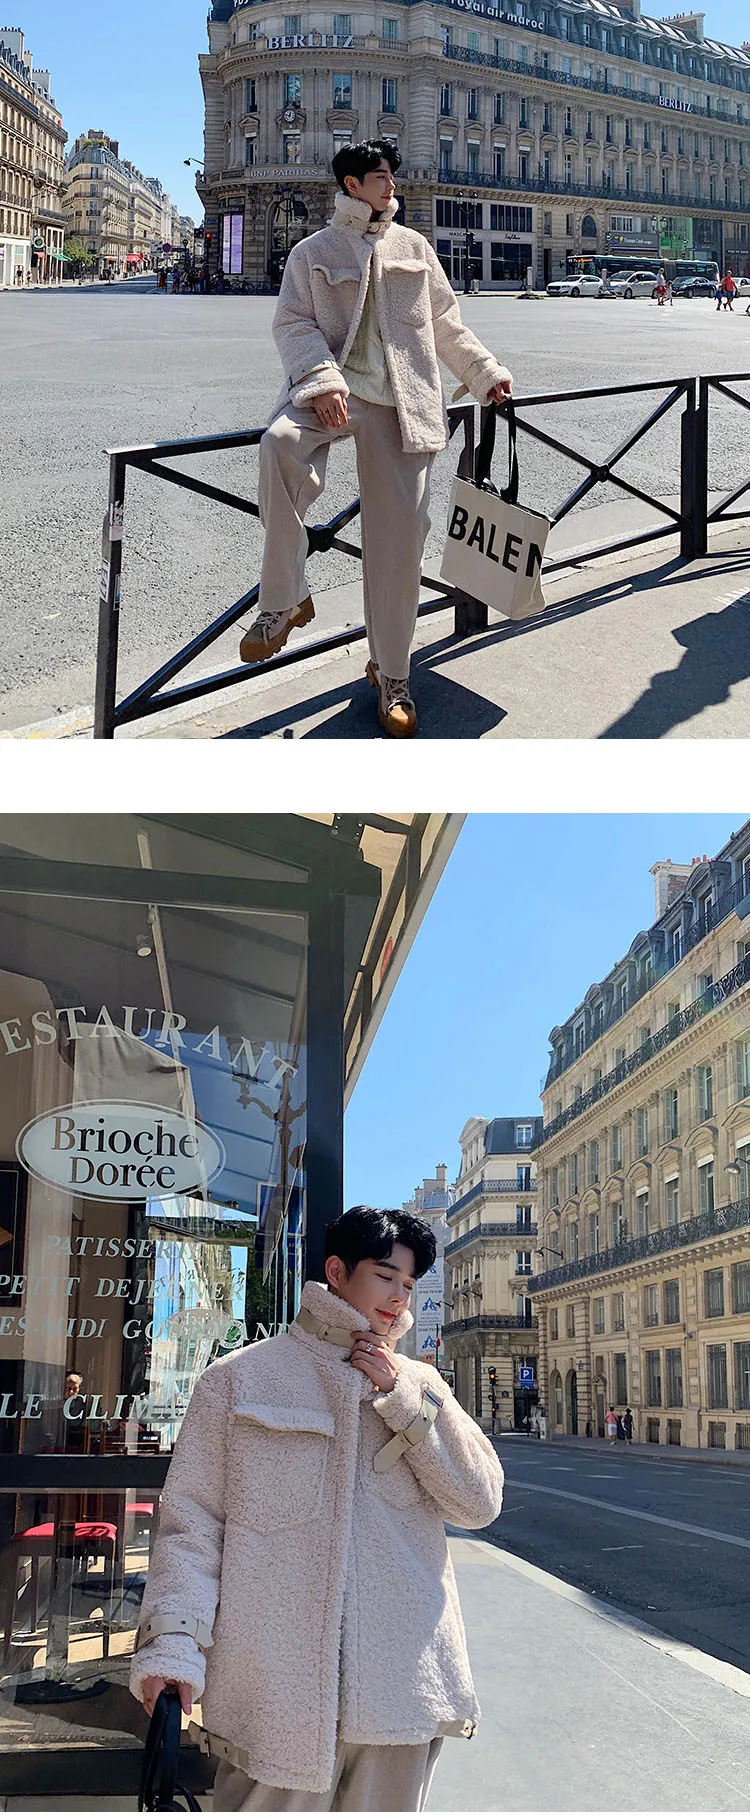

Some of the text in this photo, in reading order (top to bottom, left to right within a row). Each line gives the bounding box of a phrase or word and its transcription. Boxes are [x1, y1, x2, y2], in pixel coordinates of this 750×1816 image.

[487, 6, 504, 18] air
[507, 12, 544, 30] maroc
[268, 33, 355, 50] BERLITZ
[658, 95, 692, 113] BERLITZ
[250, 168, 318, 177] BNP PARIBAS
[51, 1116, 200, 1158] Brioche
[69, 1156, 176, 1189] Dorée
[0, 1274, 80, 1297] PETIT
[523, 1369, 530, 1379] P
[0, 1393, 44, 1419] LE
